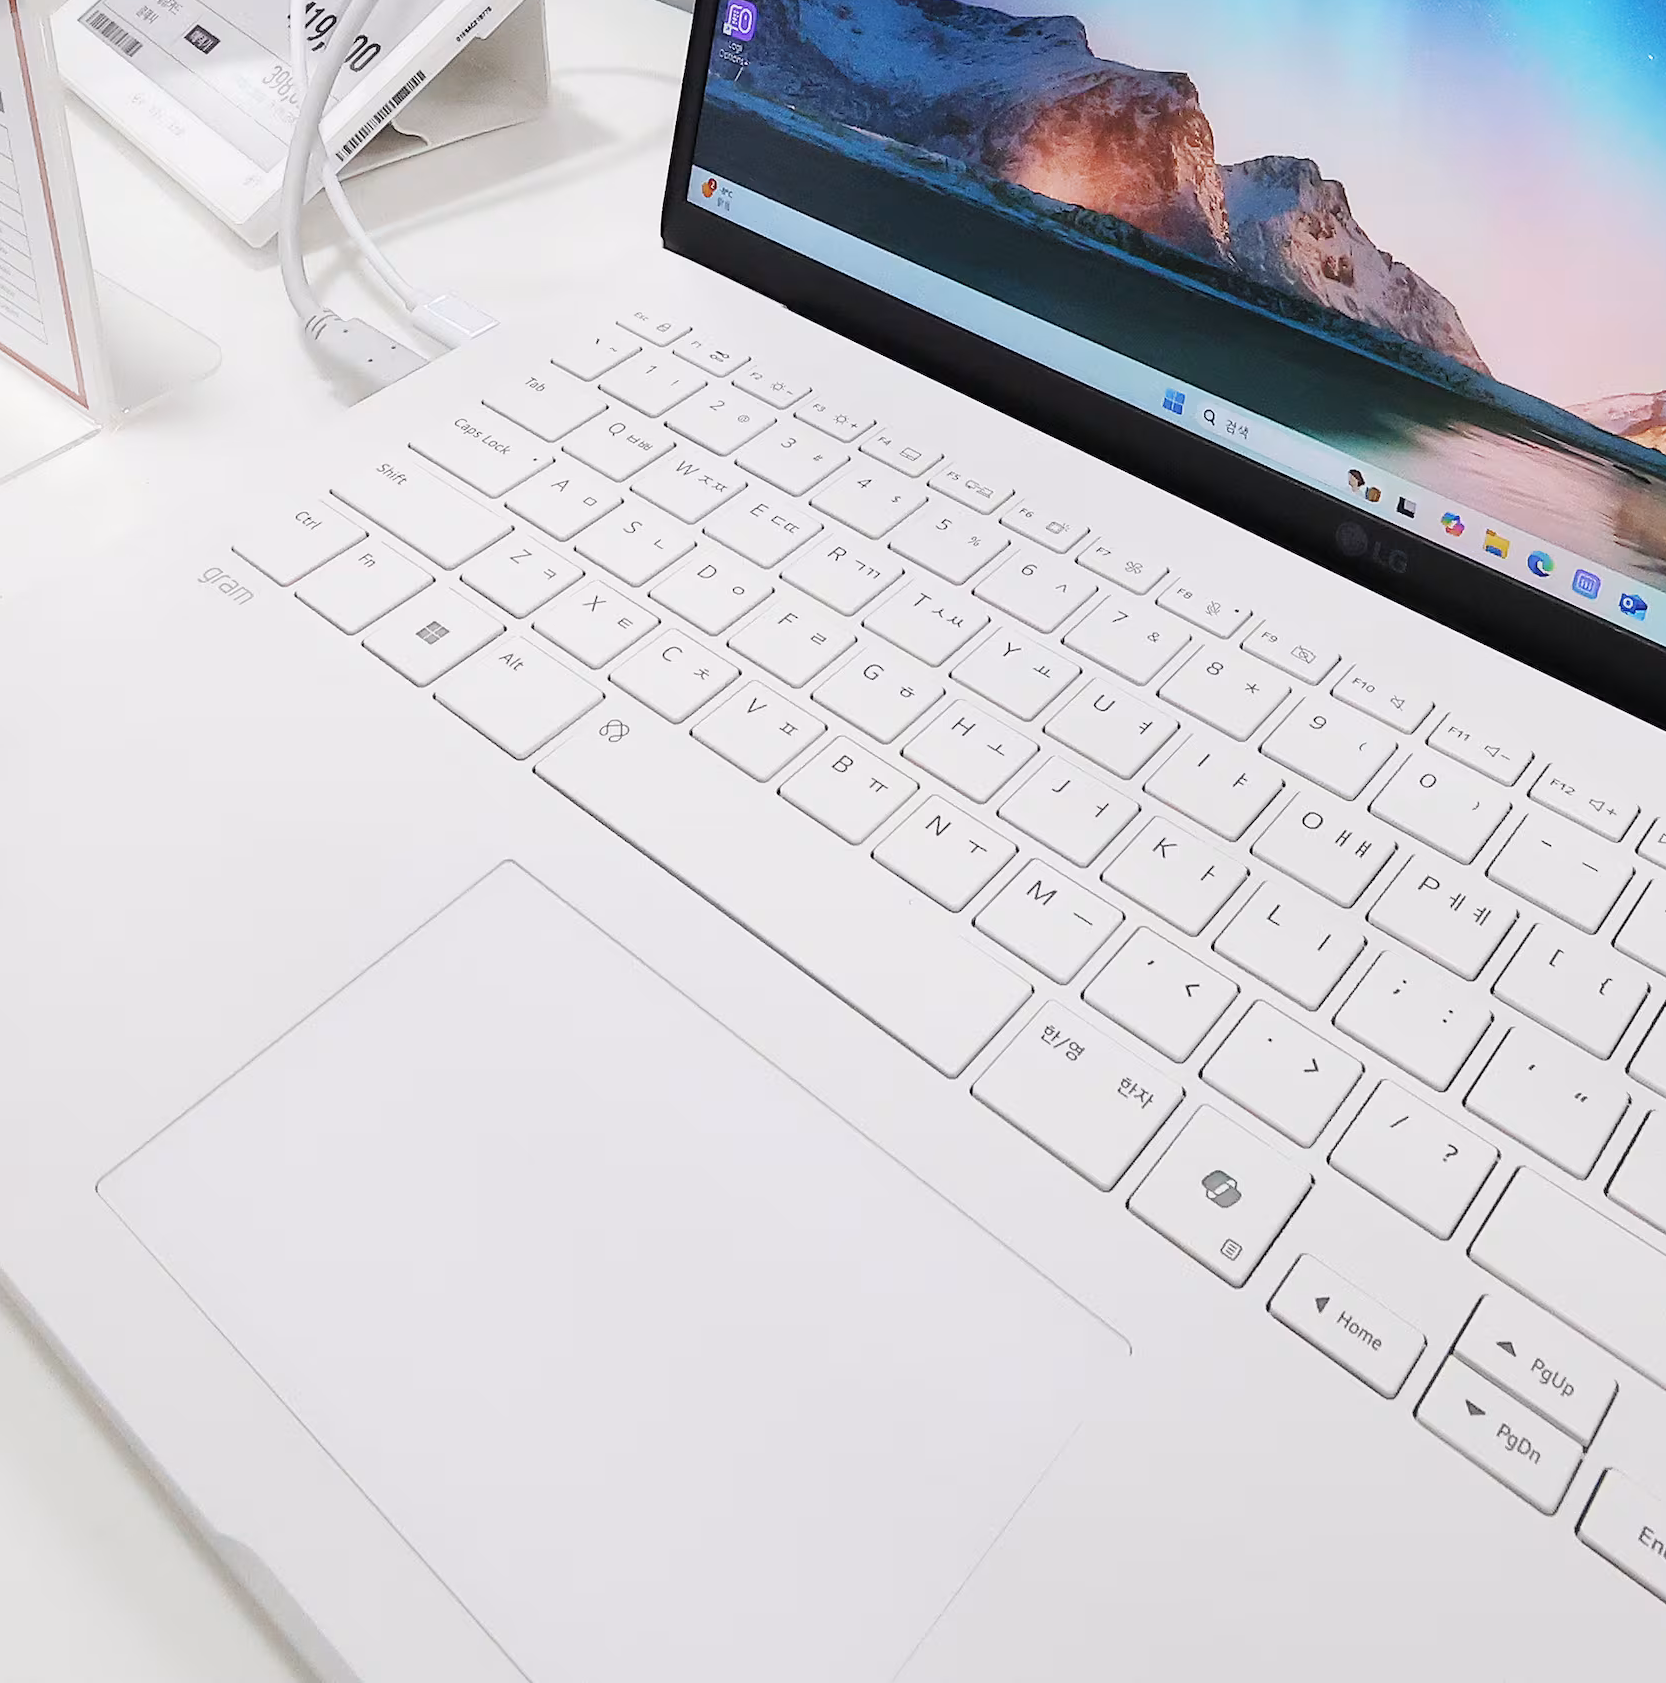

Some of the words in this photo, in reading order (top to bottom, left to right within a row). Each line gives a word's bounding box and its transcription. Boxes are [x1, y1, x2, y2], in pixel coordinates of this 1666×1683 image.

[524, 375, 547, 394] Tab
[453, 417, 485, 443] Caps
[484, 435, 511, 457] Lock
[1225, 419, 1250, 441] 검색
[376, 461, 408, 487] Shift
[293, 509, 322, 532] Ctrl
[359, 552, 378, 571] Fn
[1371, 542, 1409, 574] LG
[197, 564, 256, 608] gram
[499, 650, 525, 674] Alt
[1039, 1024, 1086, 1062] 한/영
[1116, 1075, 1155, 1109] 한자
[1336, 1311, 1383, 1351] Home
[1531, 1359, 1576, 1399] PgUp
[1496, 1424, 1543, 1465] PgDn
